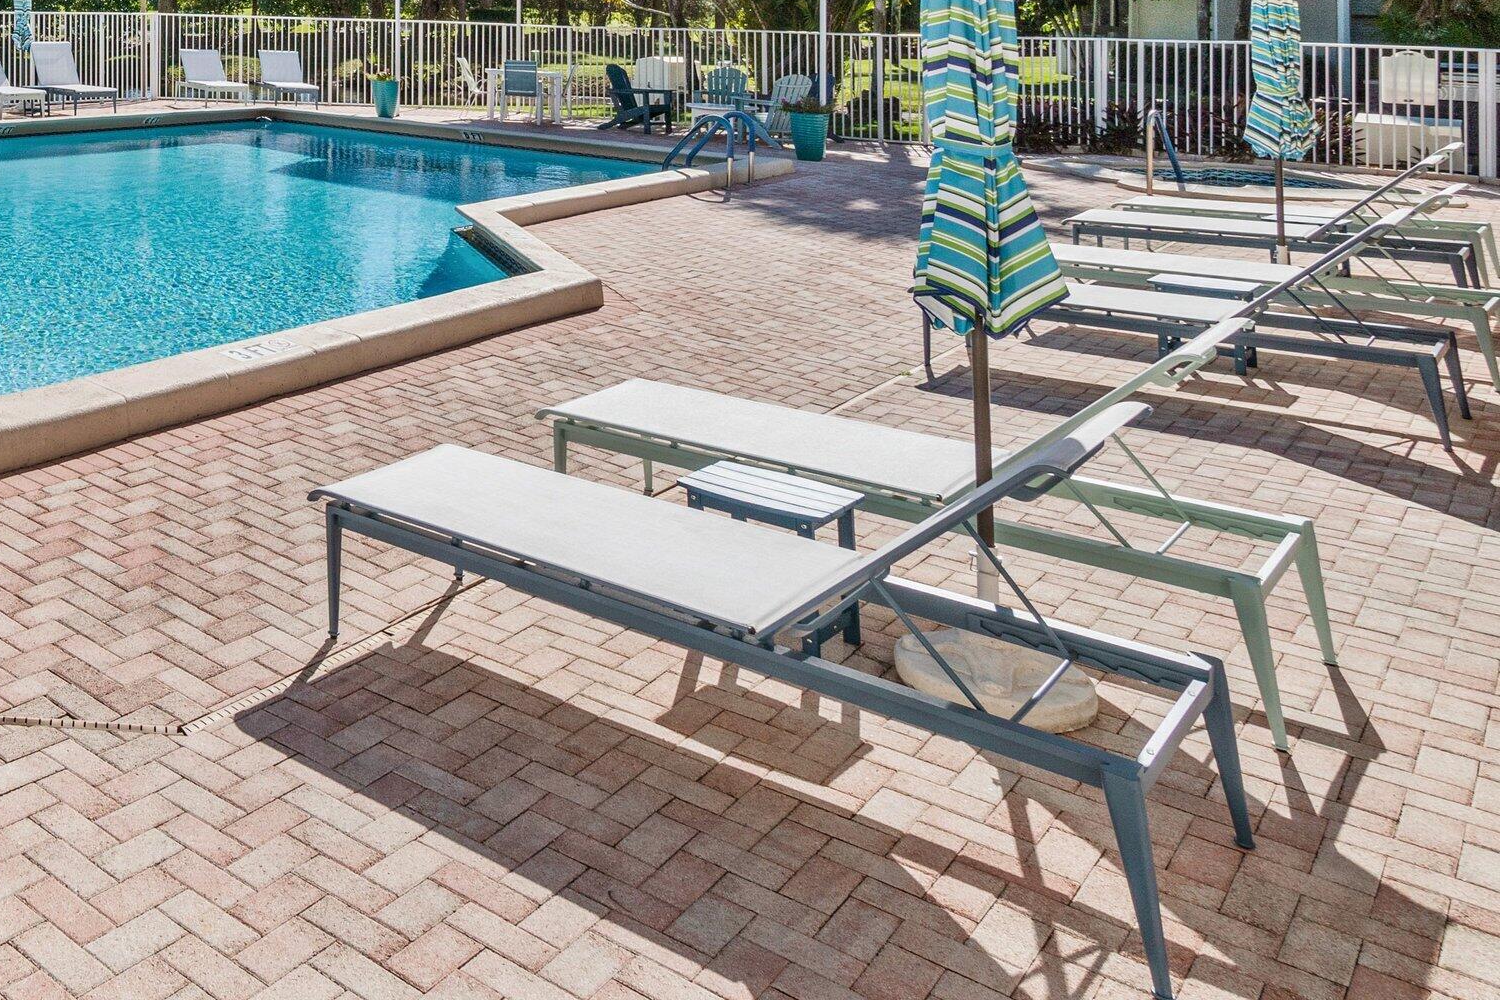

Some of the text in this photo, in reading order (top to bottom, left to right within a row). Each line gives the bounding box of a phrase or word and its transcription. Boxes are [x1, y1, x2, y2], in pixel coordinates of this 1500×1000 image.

[2, 126, 15, 135] FT
[470, 132, 482, 141] FT
[228, 343, 277, 360] 3 FT
